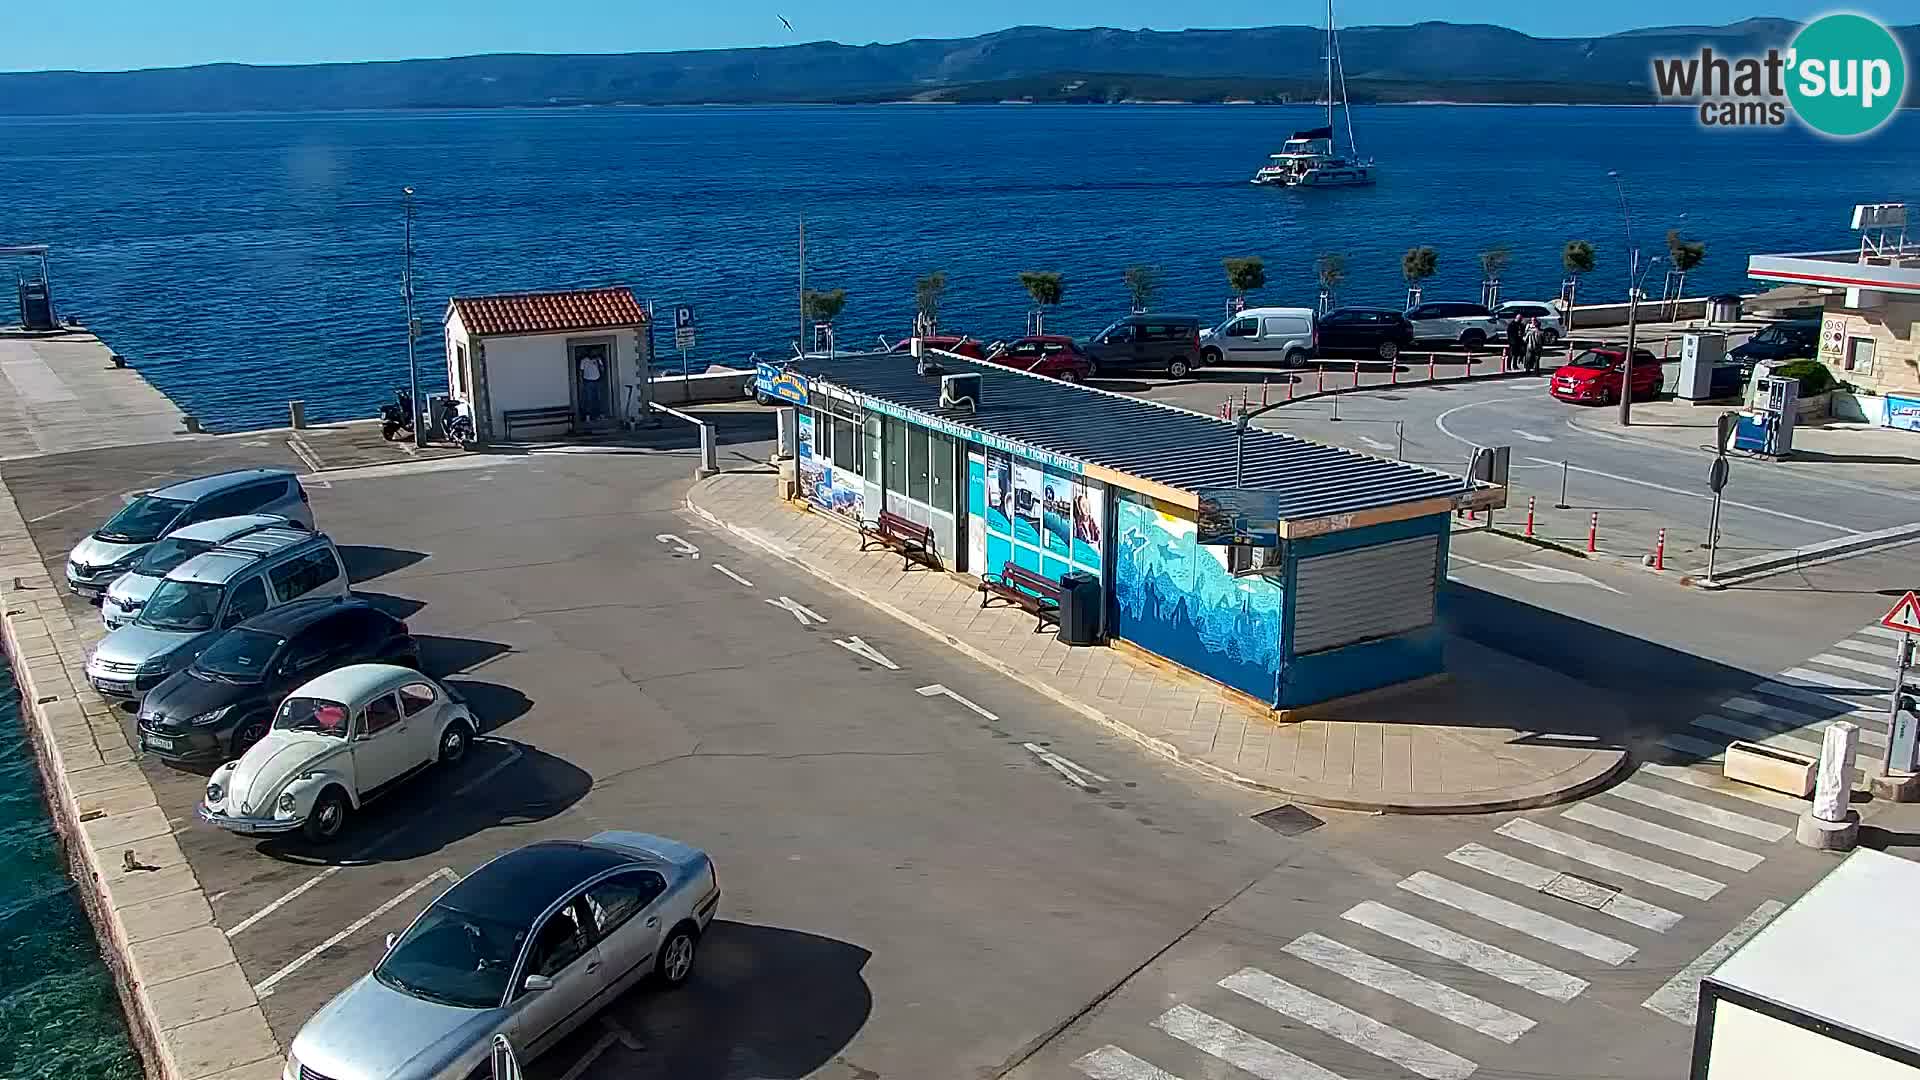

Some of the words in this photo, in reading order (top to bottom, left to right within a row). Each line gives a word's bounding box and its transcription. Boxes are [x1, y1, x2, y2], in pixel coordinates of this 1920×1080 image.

[680, 308, 690, 326] P
[996, 438, 1027, 456] STATION
[1028, 446, 1053, 464] TICKET
[1053, 453, 1079, 472] OFFICE
